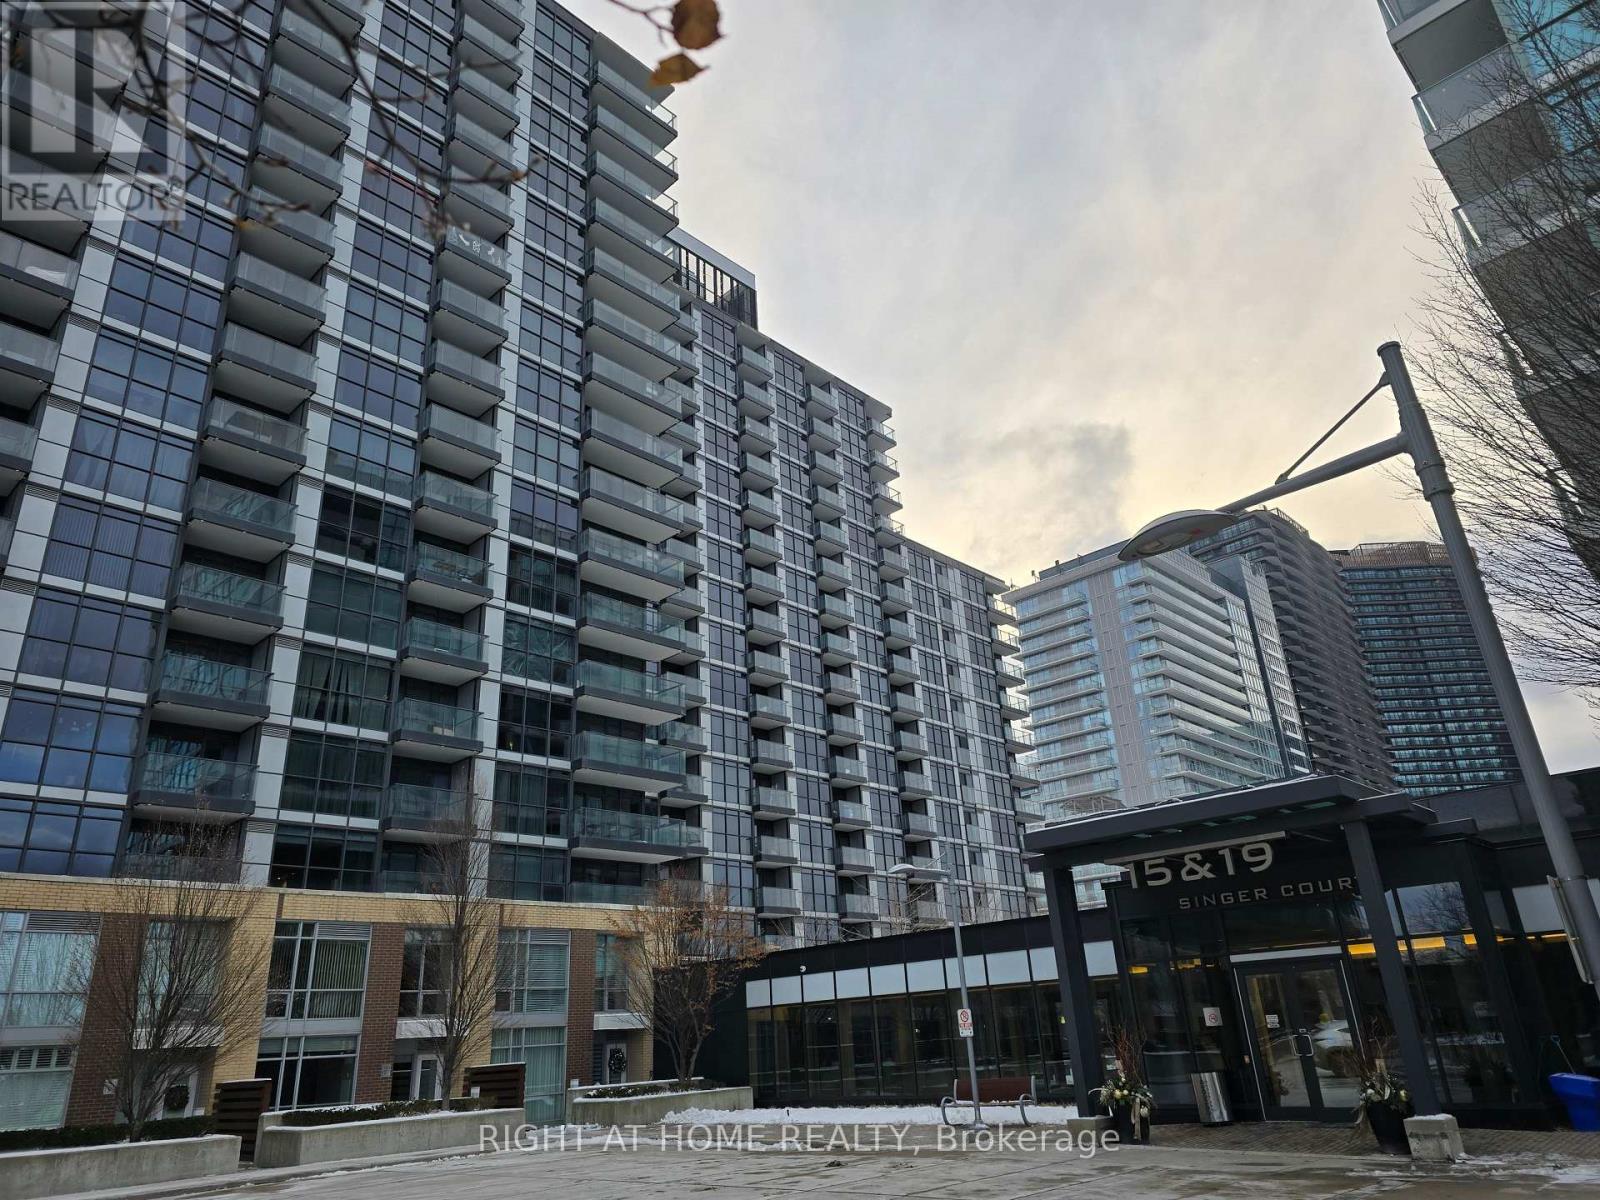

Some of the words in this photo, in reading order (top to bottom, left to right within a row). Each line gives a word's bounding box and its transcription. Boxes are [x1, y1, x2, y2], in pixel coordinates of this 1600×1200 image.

[1124, 841, 1273, 889] 15&19
[1179, 888, 1269, 910] SINGER
[1280, 876, 1357, 897] COUR
